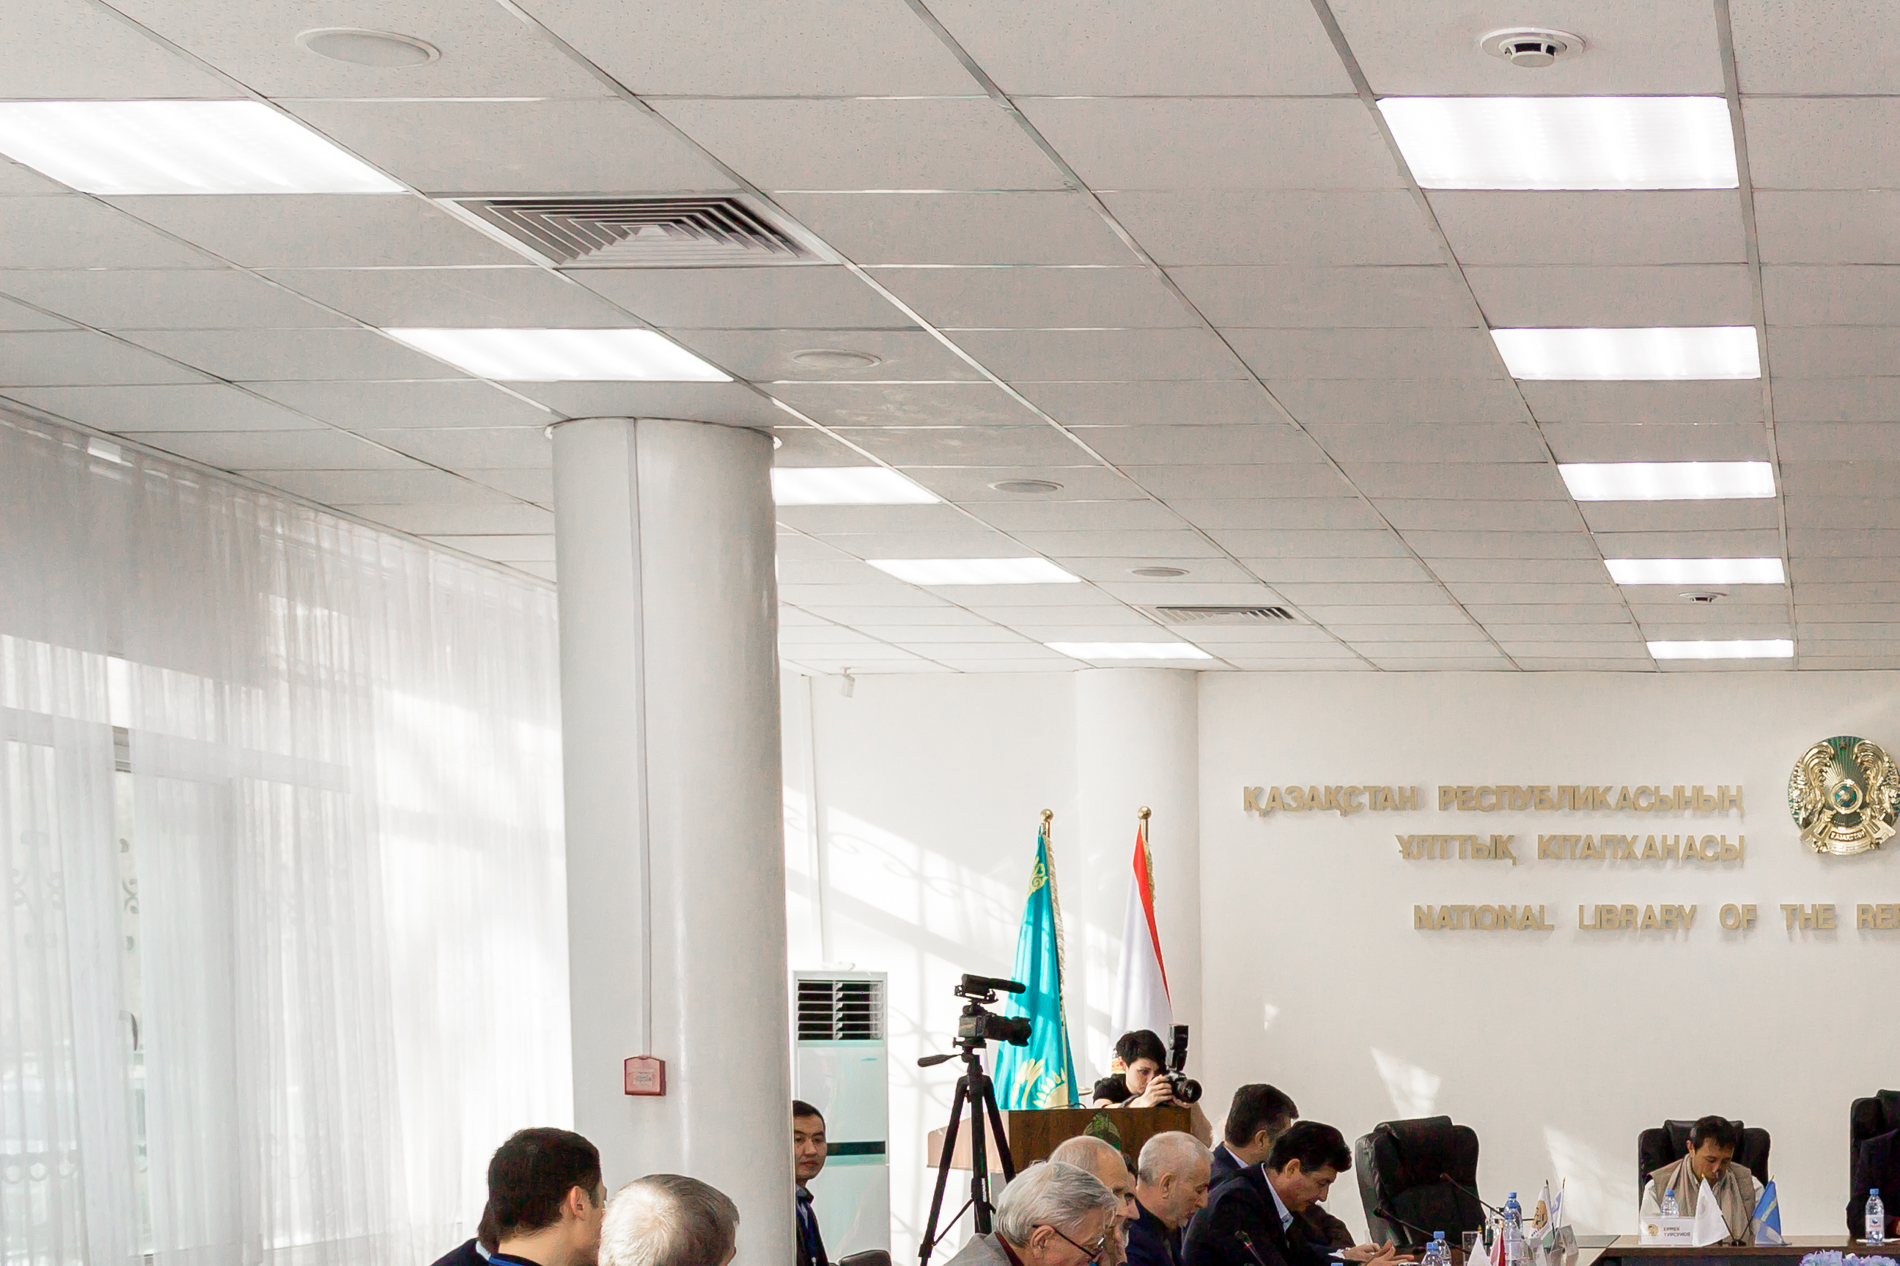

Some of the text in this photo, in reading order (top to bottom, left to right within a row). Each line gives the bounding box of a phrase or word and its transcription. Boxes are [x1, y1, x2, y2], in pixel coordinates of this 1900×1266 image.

[1242, 785, 1746, 818] ҚАЗАҚСТАН РЕСПУБЛИКАСЫНЫҢ
[1394, 834, 1745, 867] ҰЛТТЫҚ КІТАПХАНАСЫ
[1413, 904, 1555, 931] NATIONAL
[1578, 904, 1697, 931] LIBRARY
[1719, 903, 1758, 931] OF
[1780, 903, 1836, 930] THE
